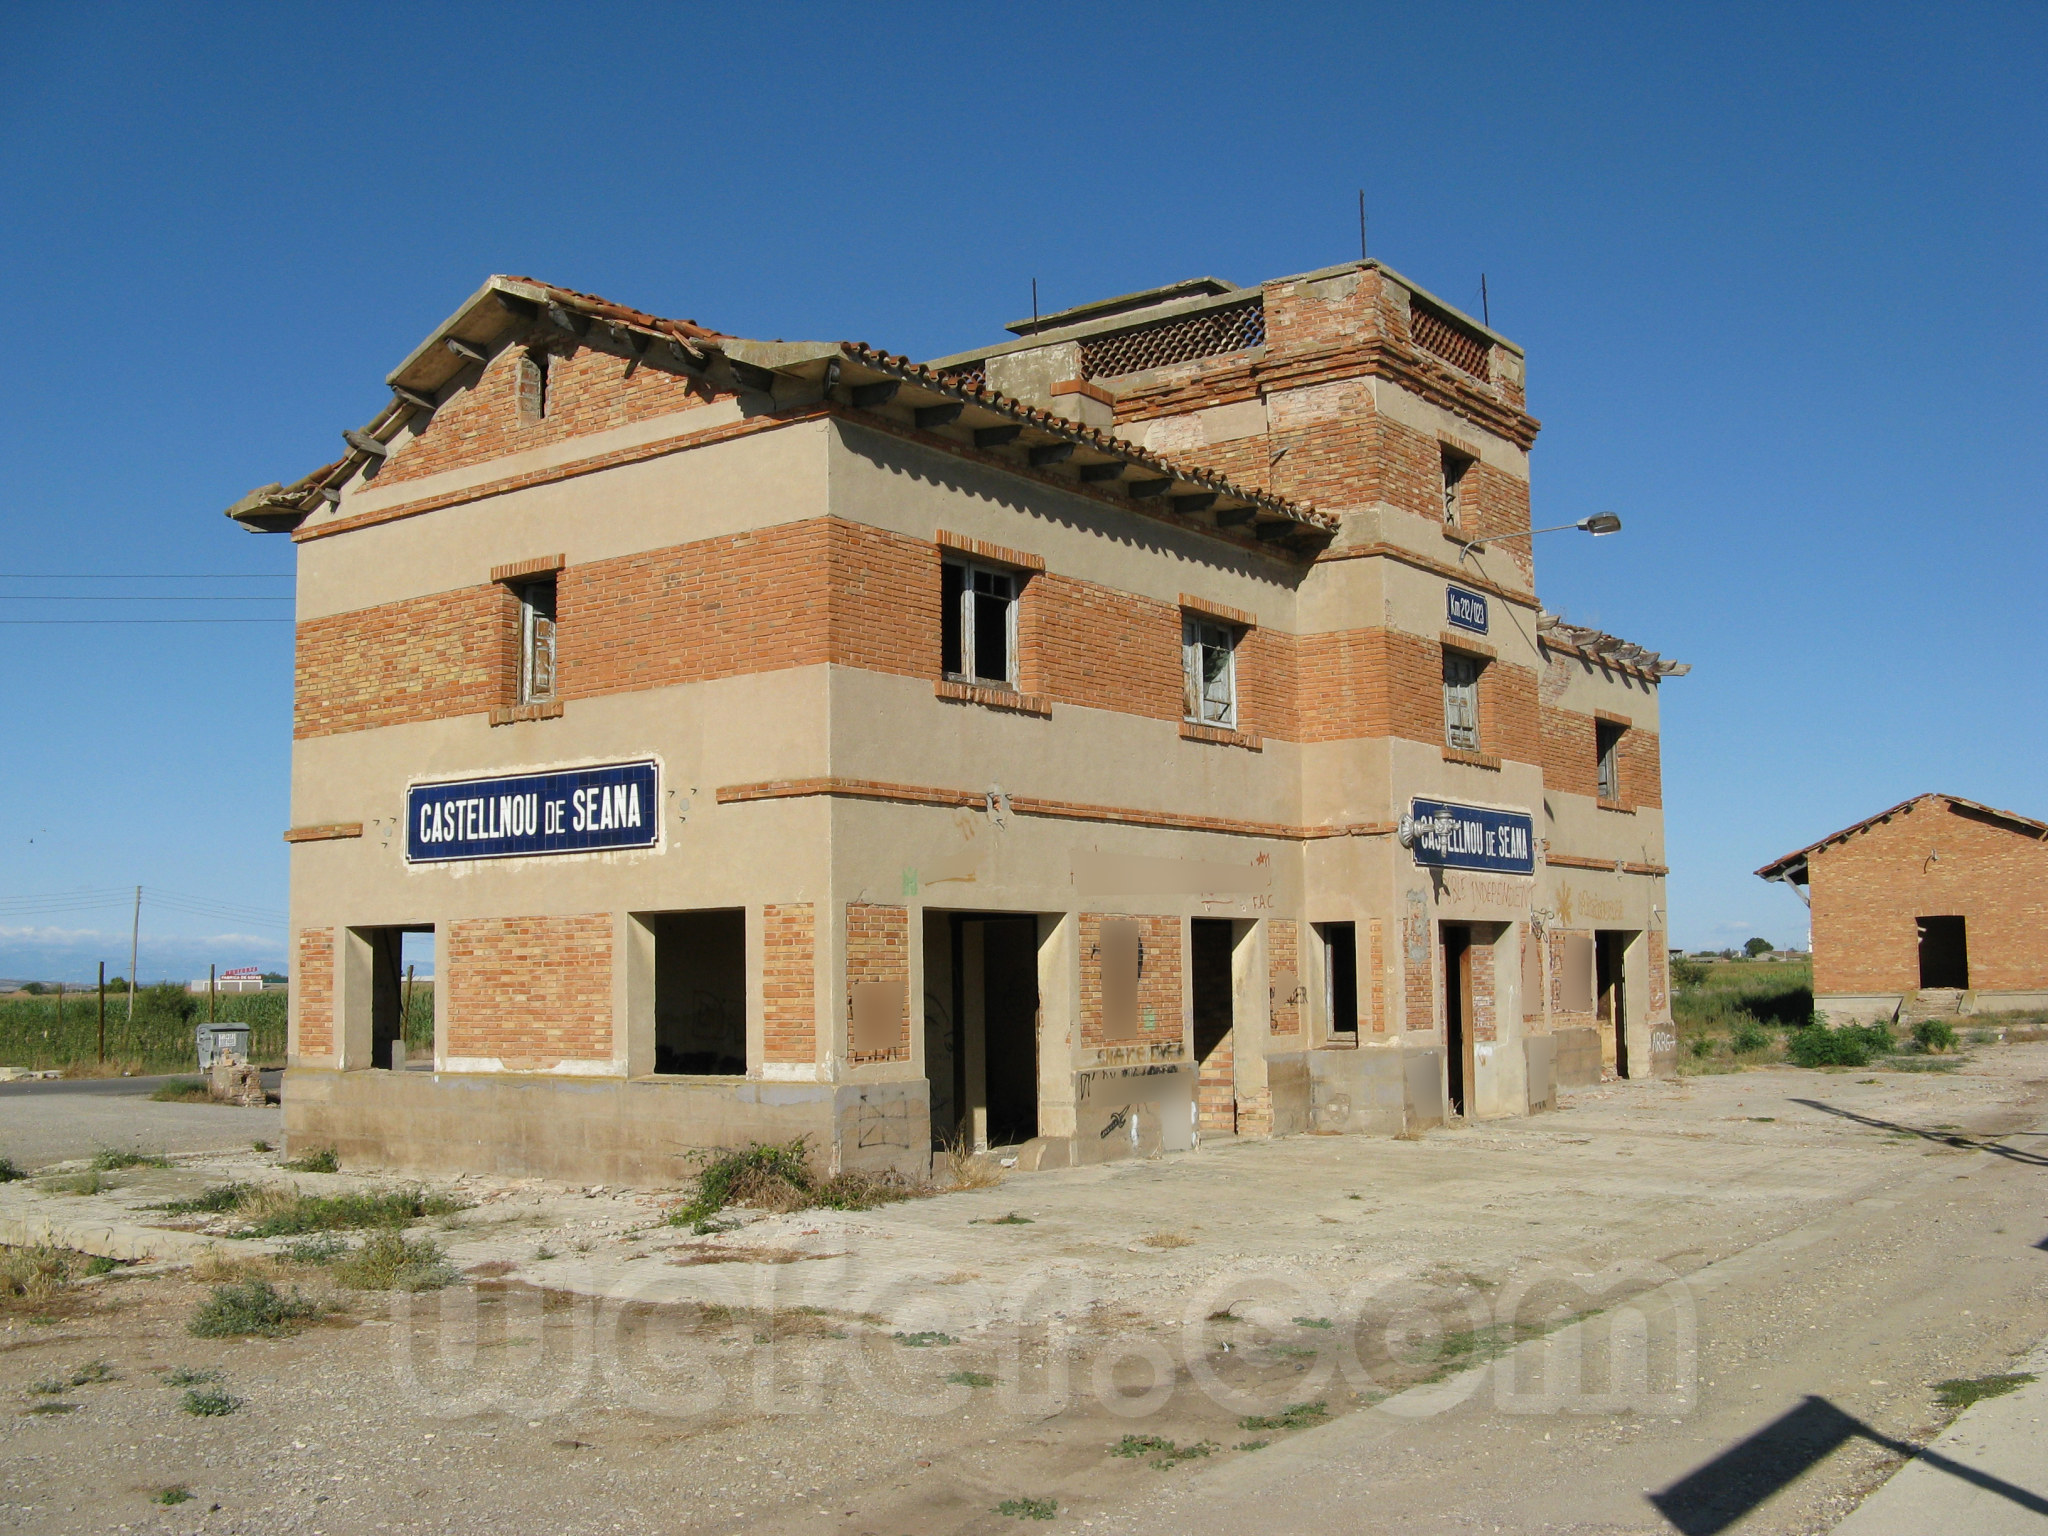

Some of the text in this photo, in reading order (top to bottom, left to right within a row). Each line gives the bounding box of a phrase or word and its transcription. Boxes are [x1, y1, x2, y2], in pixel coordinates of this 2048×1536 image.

[1450, 594, 1461, 618] Km
[419, 783, 642, 843] CASTELLNOU DE SEANA
[1420, 814, 1528, 861] CASELLNOU DE SEANA
